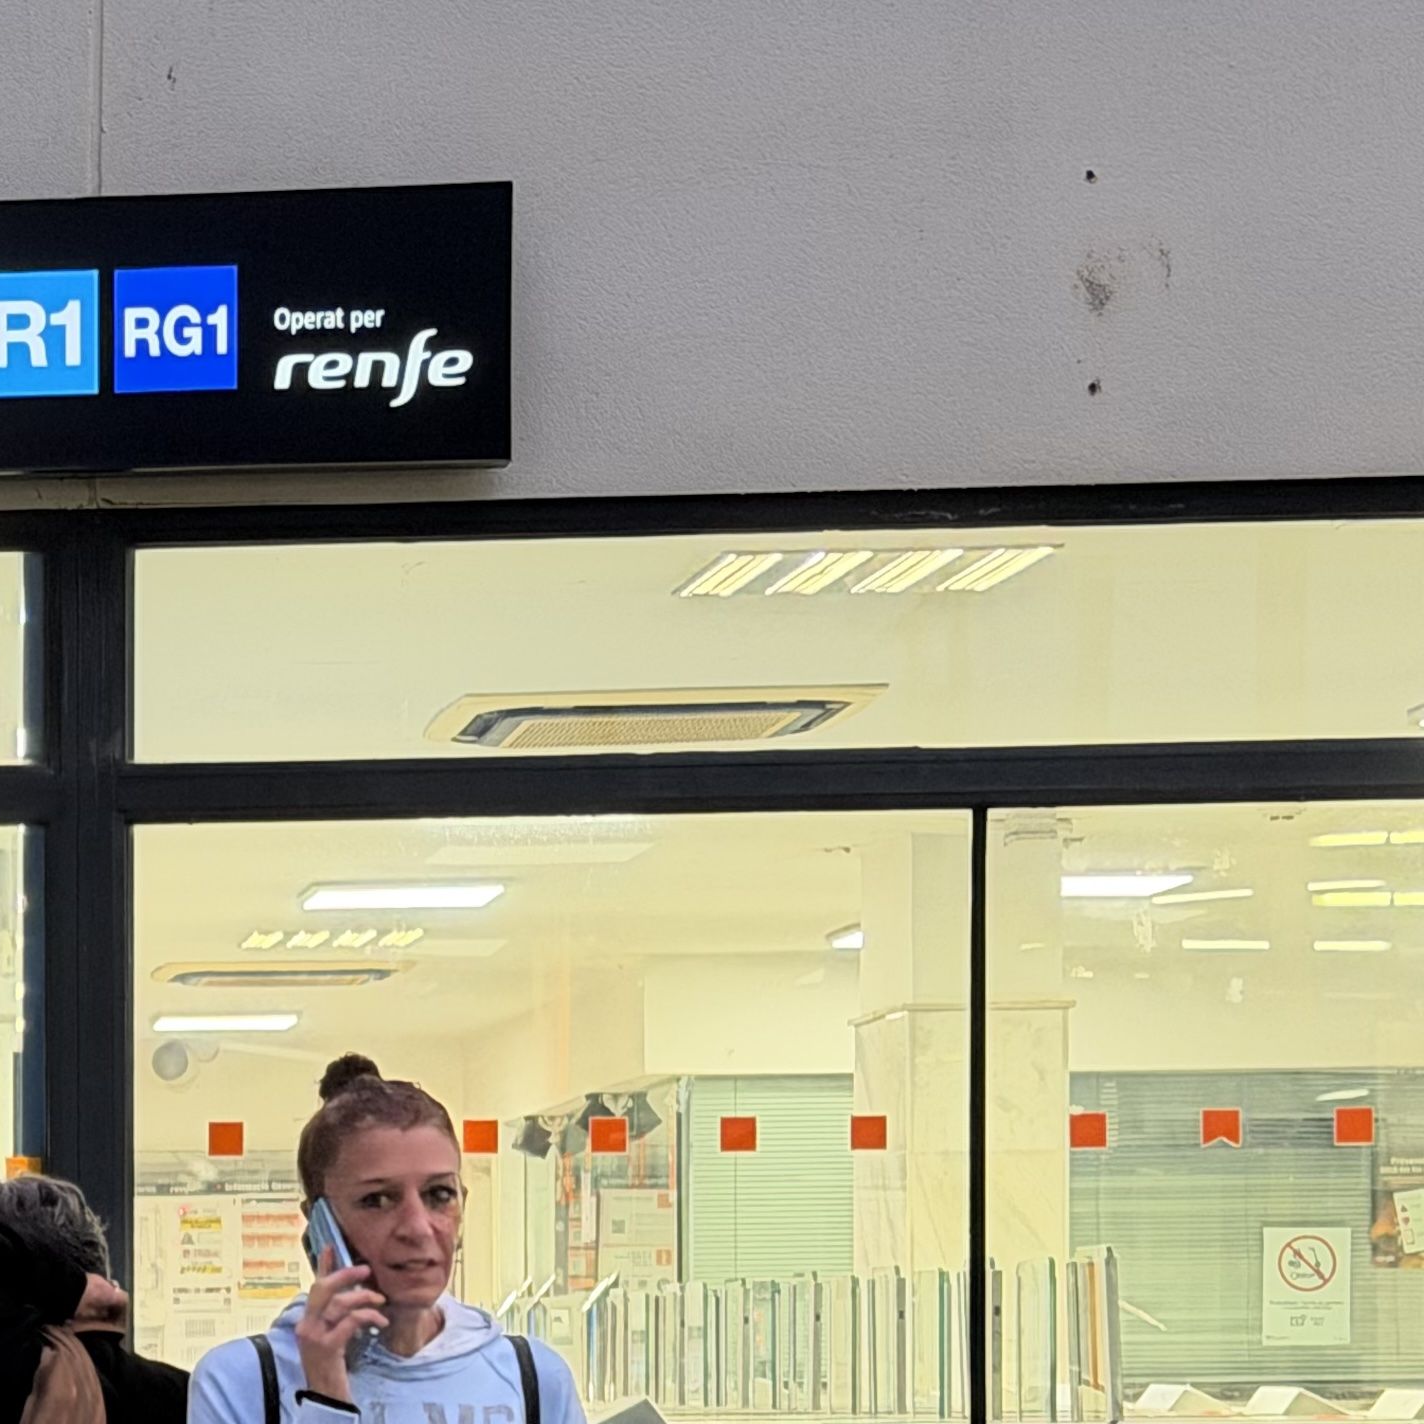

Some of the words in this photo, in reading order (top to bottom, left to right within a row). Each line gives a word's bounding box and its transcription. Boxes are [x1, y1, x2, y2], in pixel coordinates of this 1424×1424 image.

[123, 304, 229, 359] RG1
[273, 307, 345, 335] Operat
[350, 307, 385, 335] per
[272, 327, 474, 408] renfe
